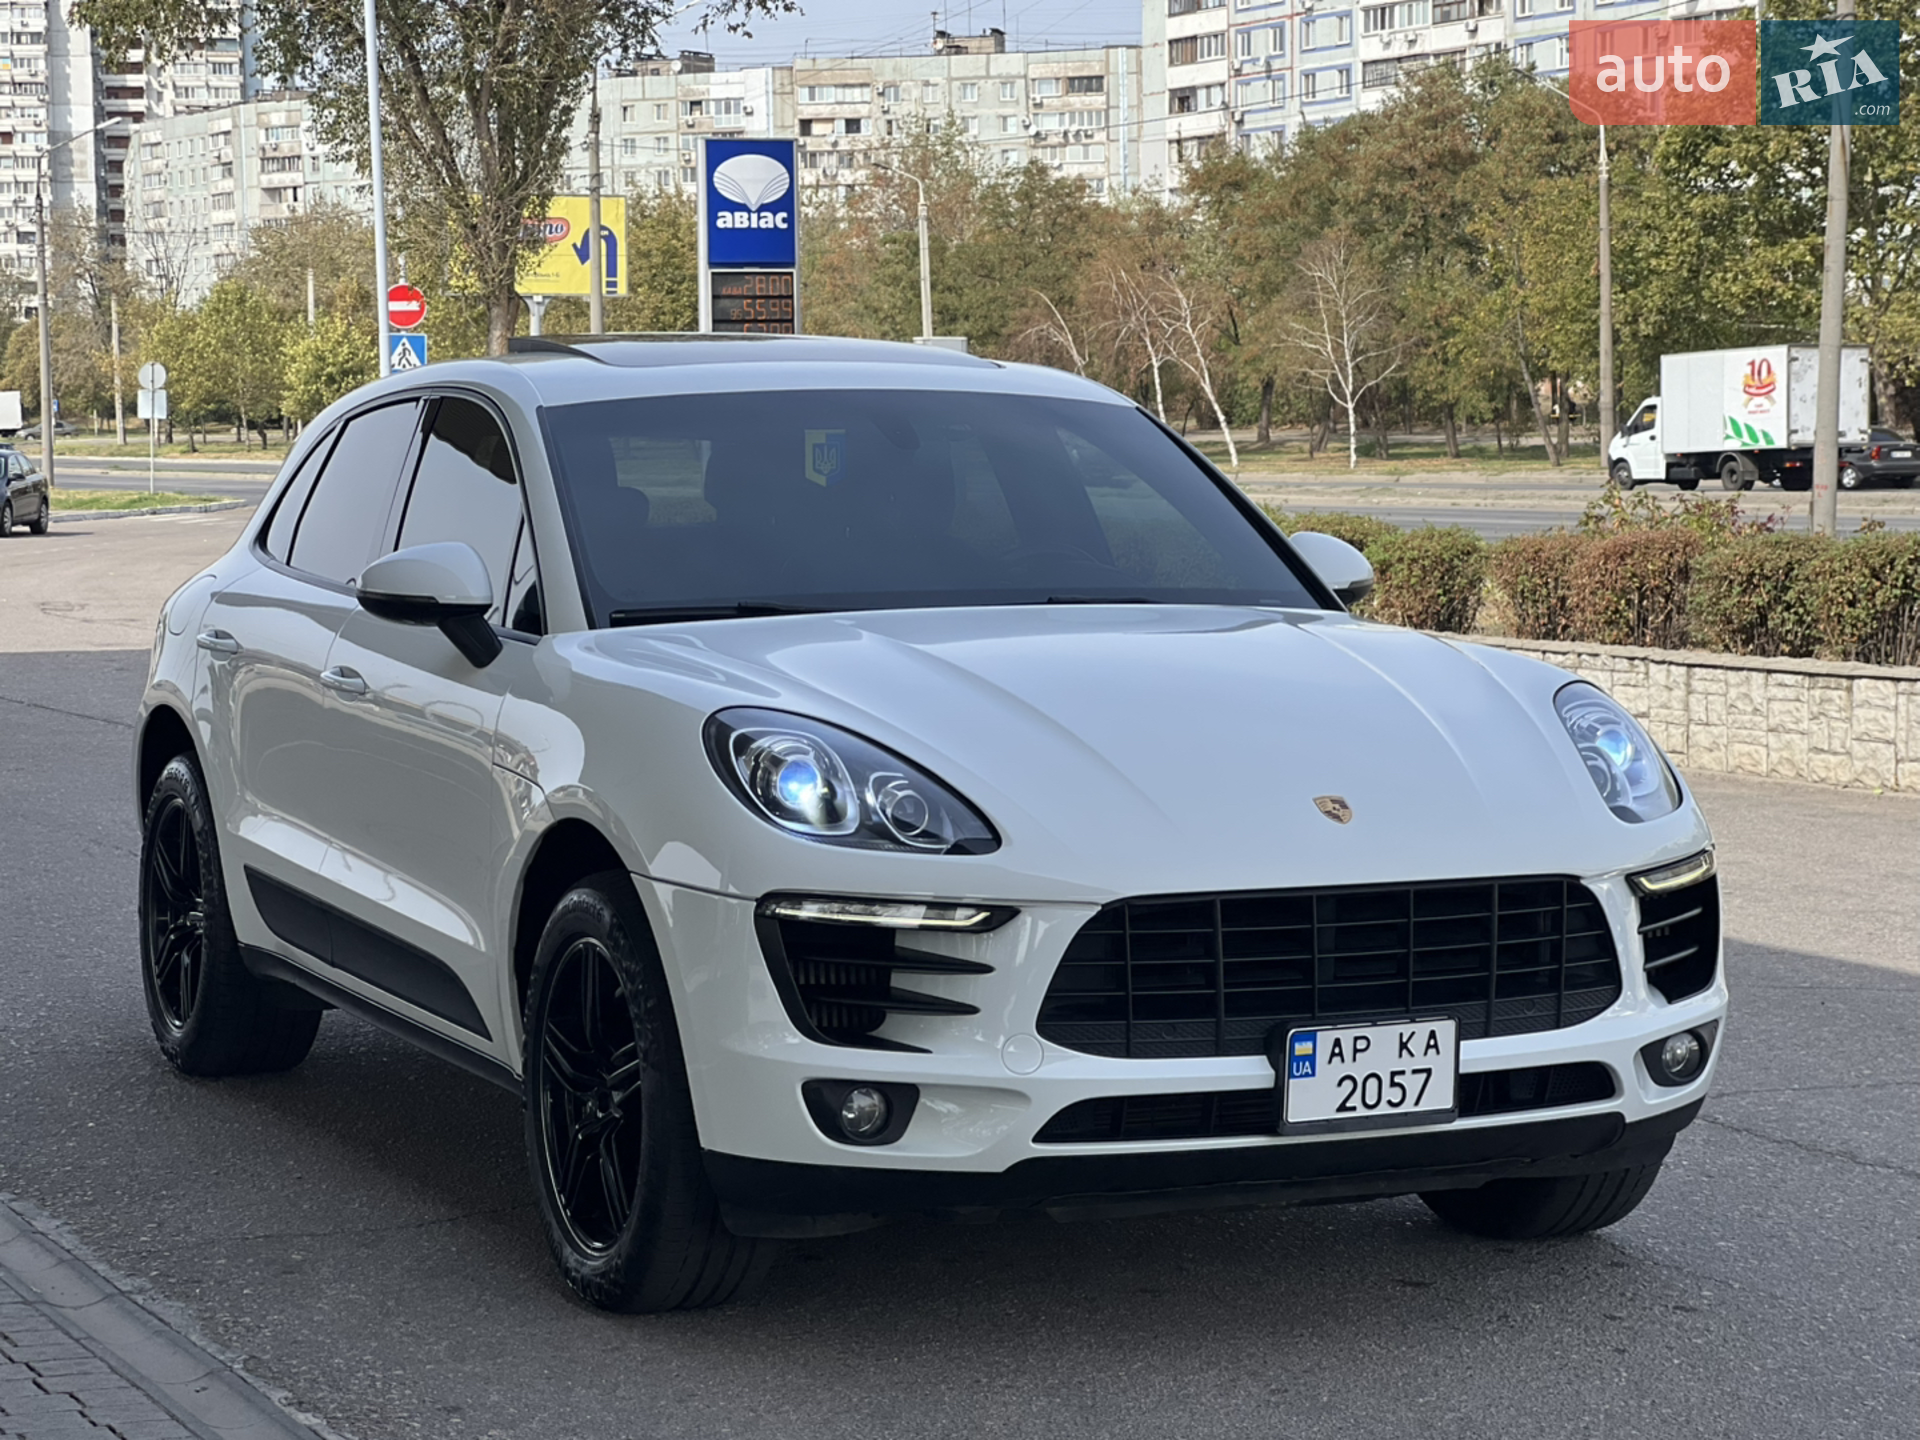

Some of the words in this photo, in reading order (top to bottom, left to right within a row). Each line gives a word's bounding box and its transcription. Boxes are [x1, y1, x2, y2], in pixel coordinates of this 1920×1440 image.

[1747, 358, 1772, 385] 10
[1327, 1035, 1371, 1065] AP
[1398, 1029, 1440, 1059] KA
[1293, 1061, 1312, 1076] UA
[1336, 1068, 1433, 1113] 2057
